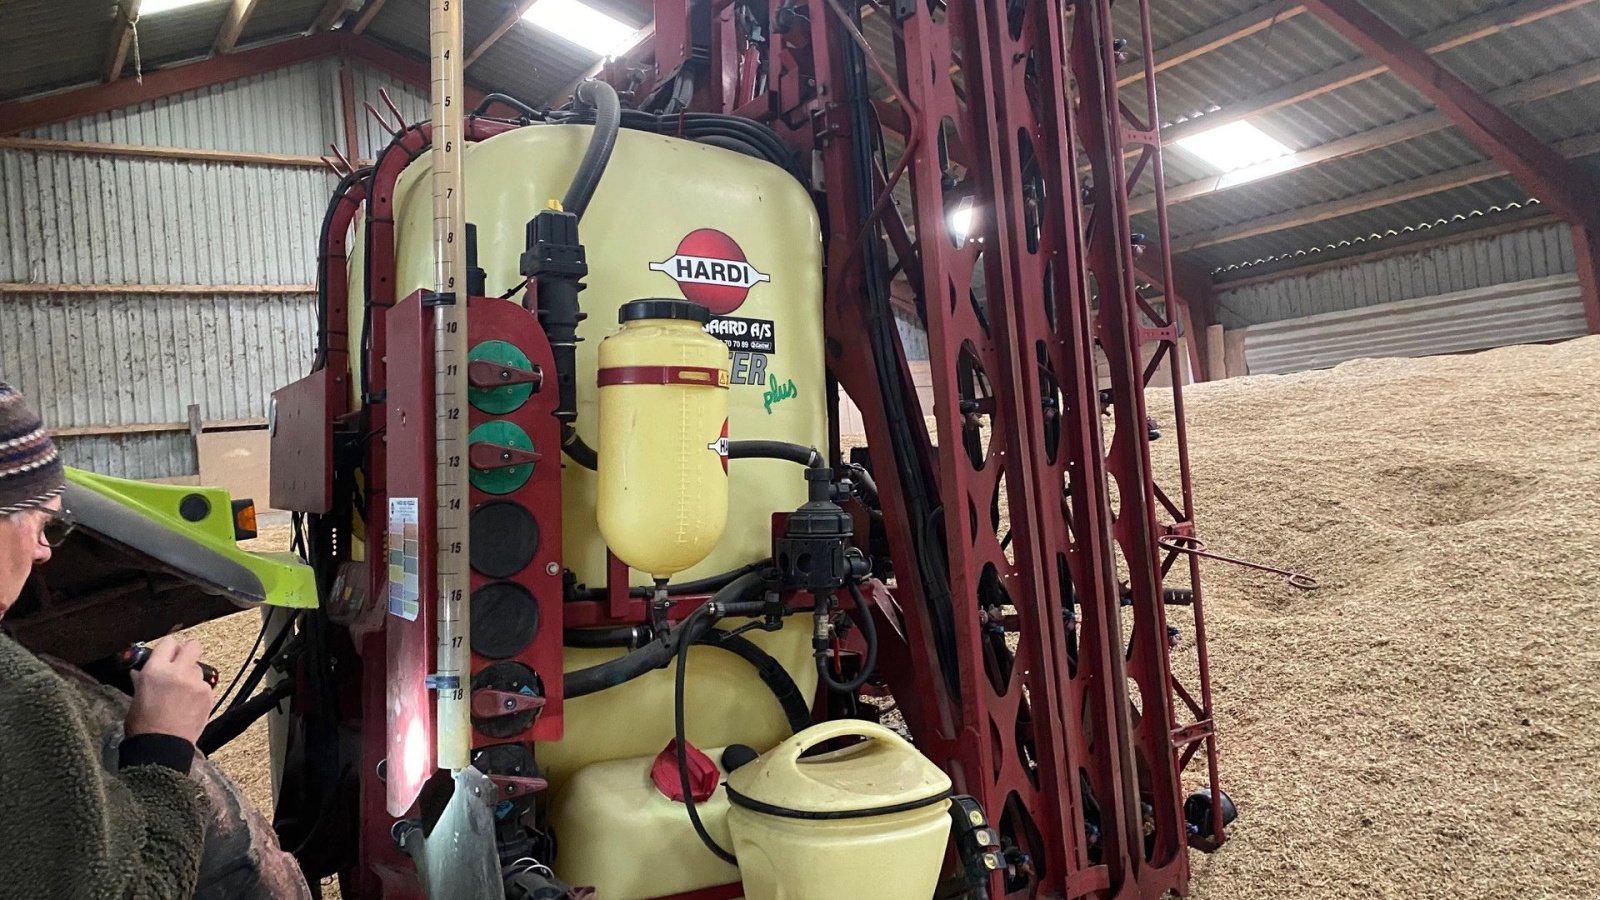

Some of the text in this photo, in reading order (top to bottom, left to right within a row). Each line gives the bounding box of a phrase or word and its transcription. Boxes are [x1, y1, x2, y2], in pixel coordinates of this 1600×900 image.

[443, 1, 450, 12] 3
[444, 50, 450, 61] 4
[444, 96, 451, 107] 5
[445, 142, 452, 152] 6
[446, 188, 453, 199] 7
[447, 232, 453, 243] 8
[676, 258, 749, 284] HARDI
[448, 277, 455, 288] 9
[446, 322, 457, 333] 10
[750, 322, 772, 340] A/S
[733, 340, 741, 348] 70
[447, 364, 457, 376] 11
[728, 352, 768, 386] ER
[763, 373, 798, 415] plus
[448, 408, 459, 420] 12
[448, 456, 460, 467] 13
[449, 498, 461, 510] 14
[450, 542, 461, 554] 15
[451, 589, 462, 601] 16
[452, 636, 463, 648] 17
[452, 688, 463, 700] 18
